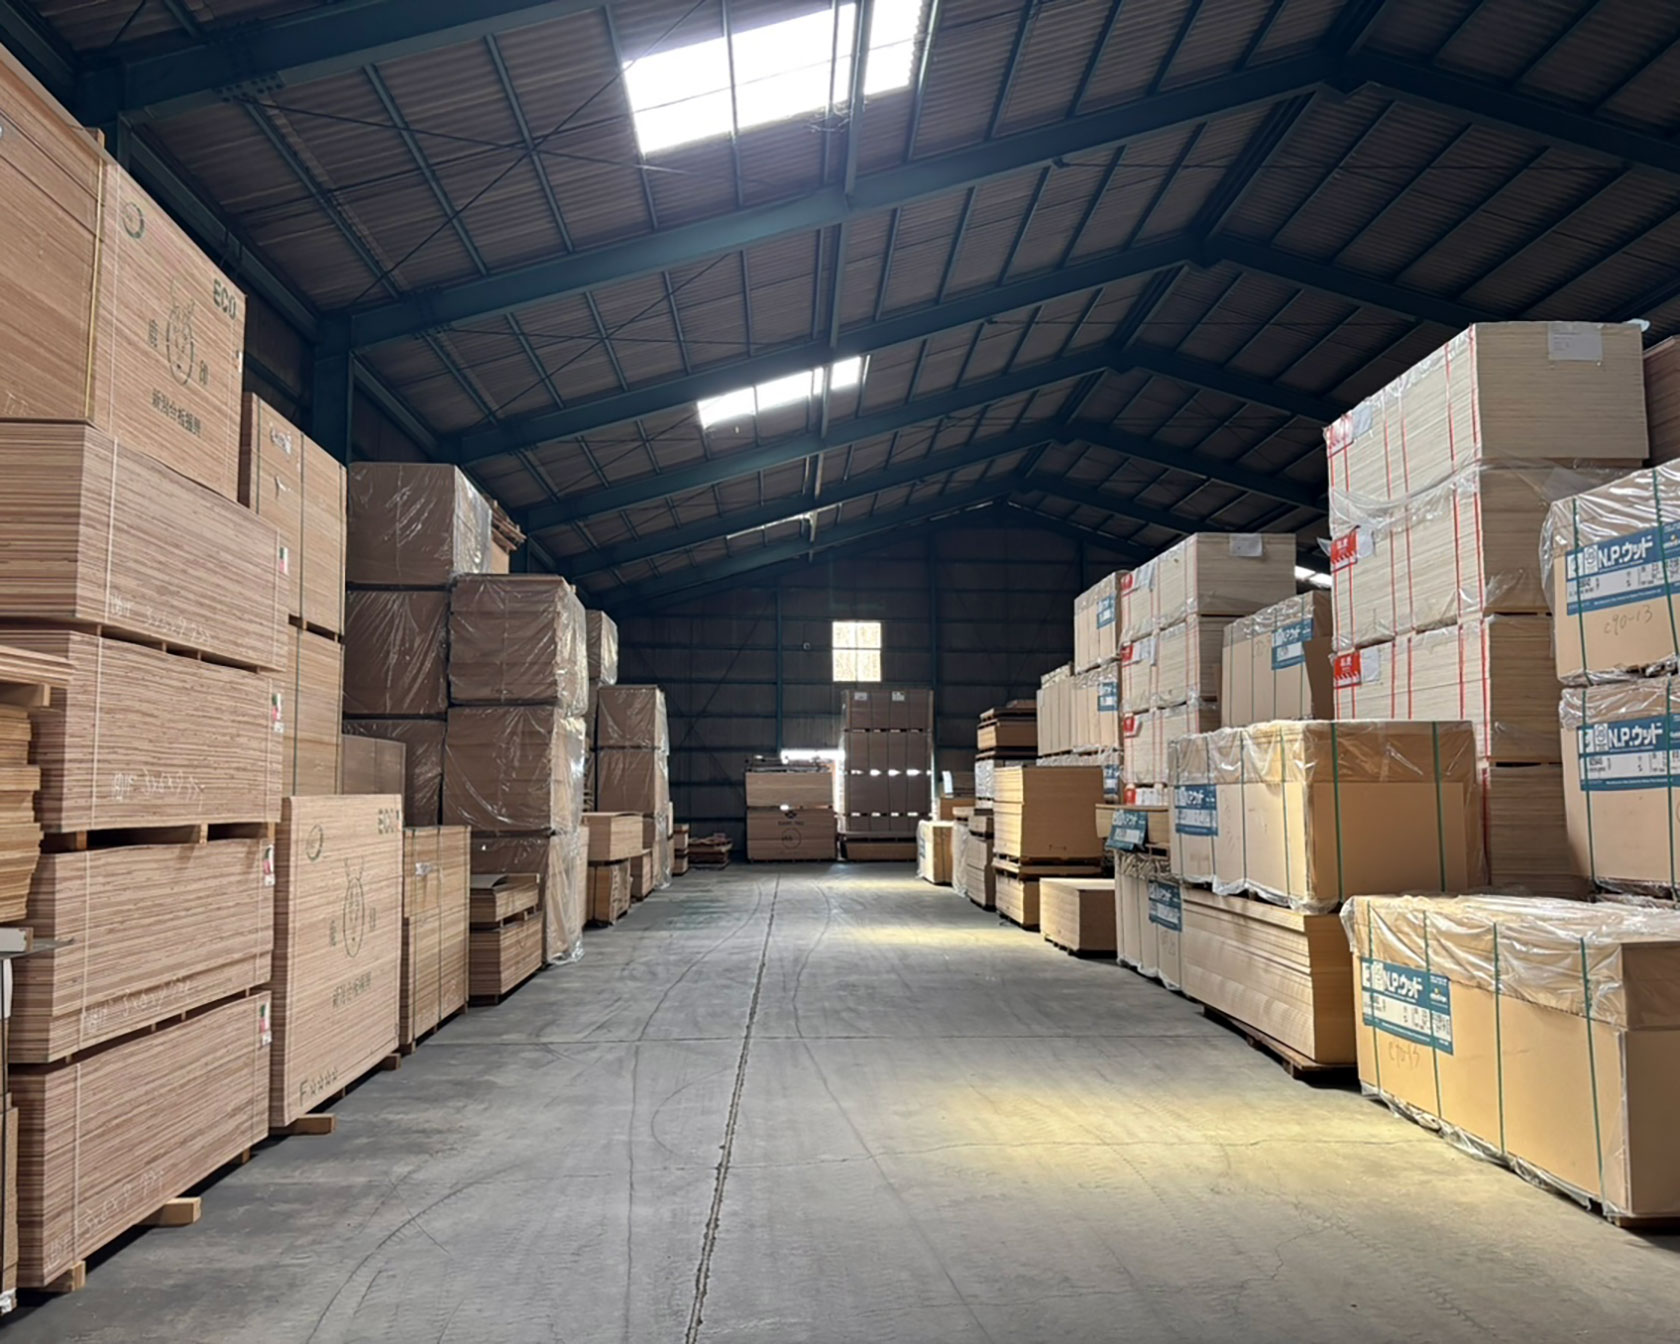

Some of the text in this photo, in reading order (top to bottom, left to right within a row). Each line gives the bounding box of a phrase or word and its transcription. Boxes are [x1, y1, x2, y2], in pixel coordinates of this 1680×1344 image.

[213, 278, 237, 321] ECO
[1599, 535, 1654, 568] N.P.ウッド
[1608, 722, 1664, 749] N.P.ウッド
